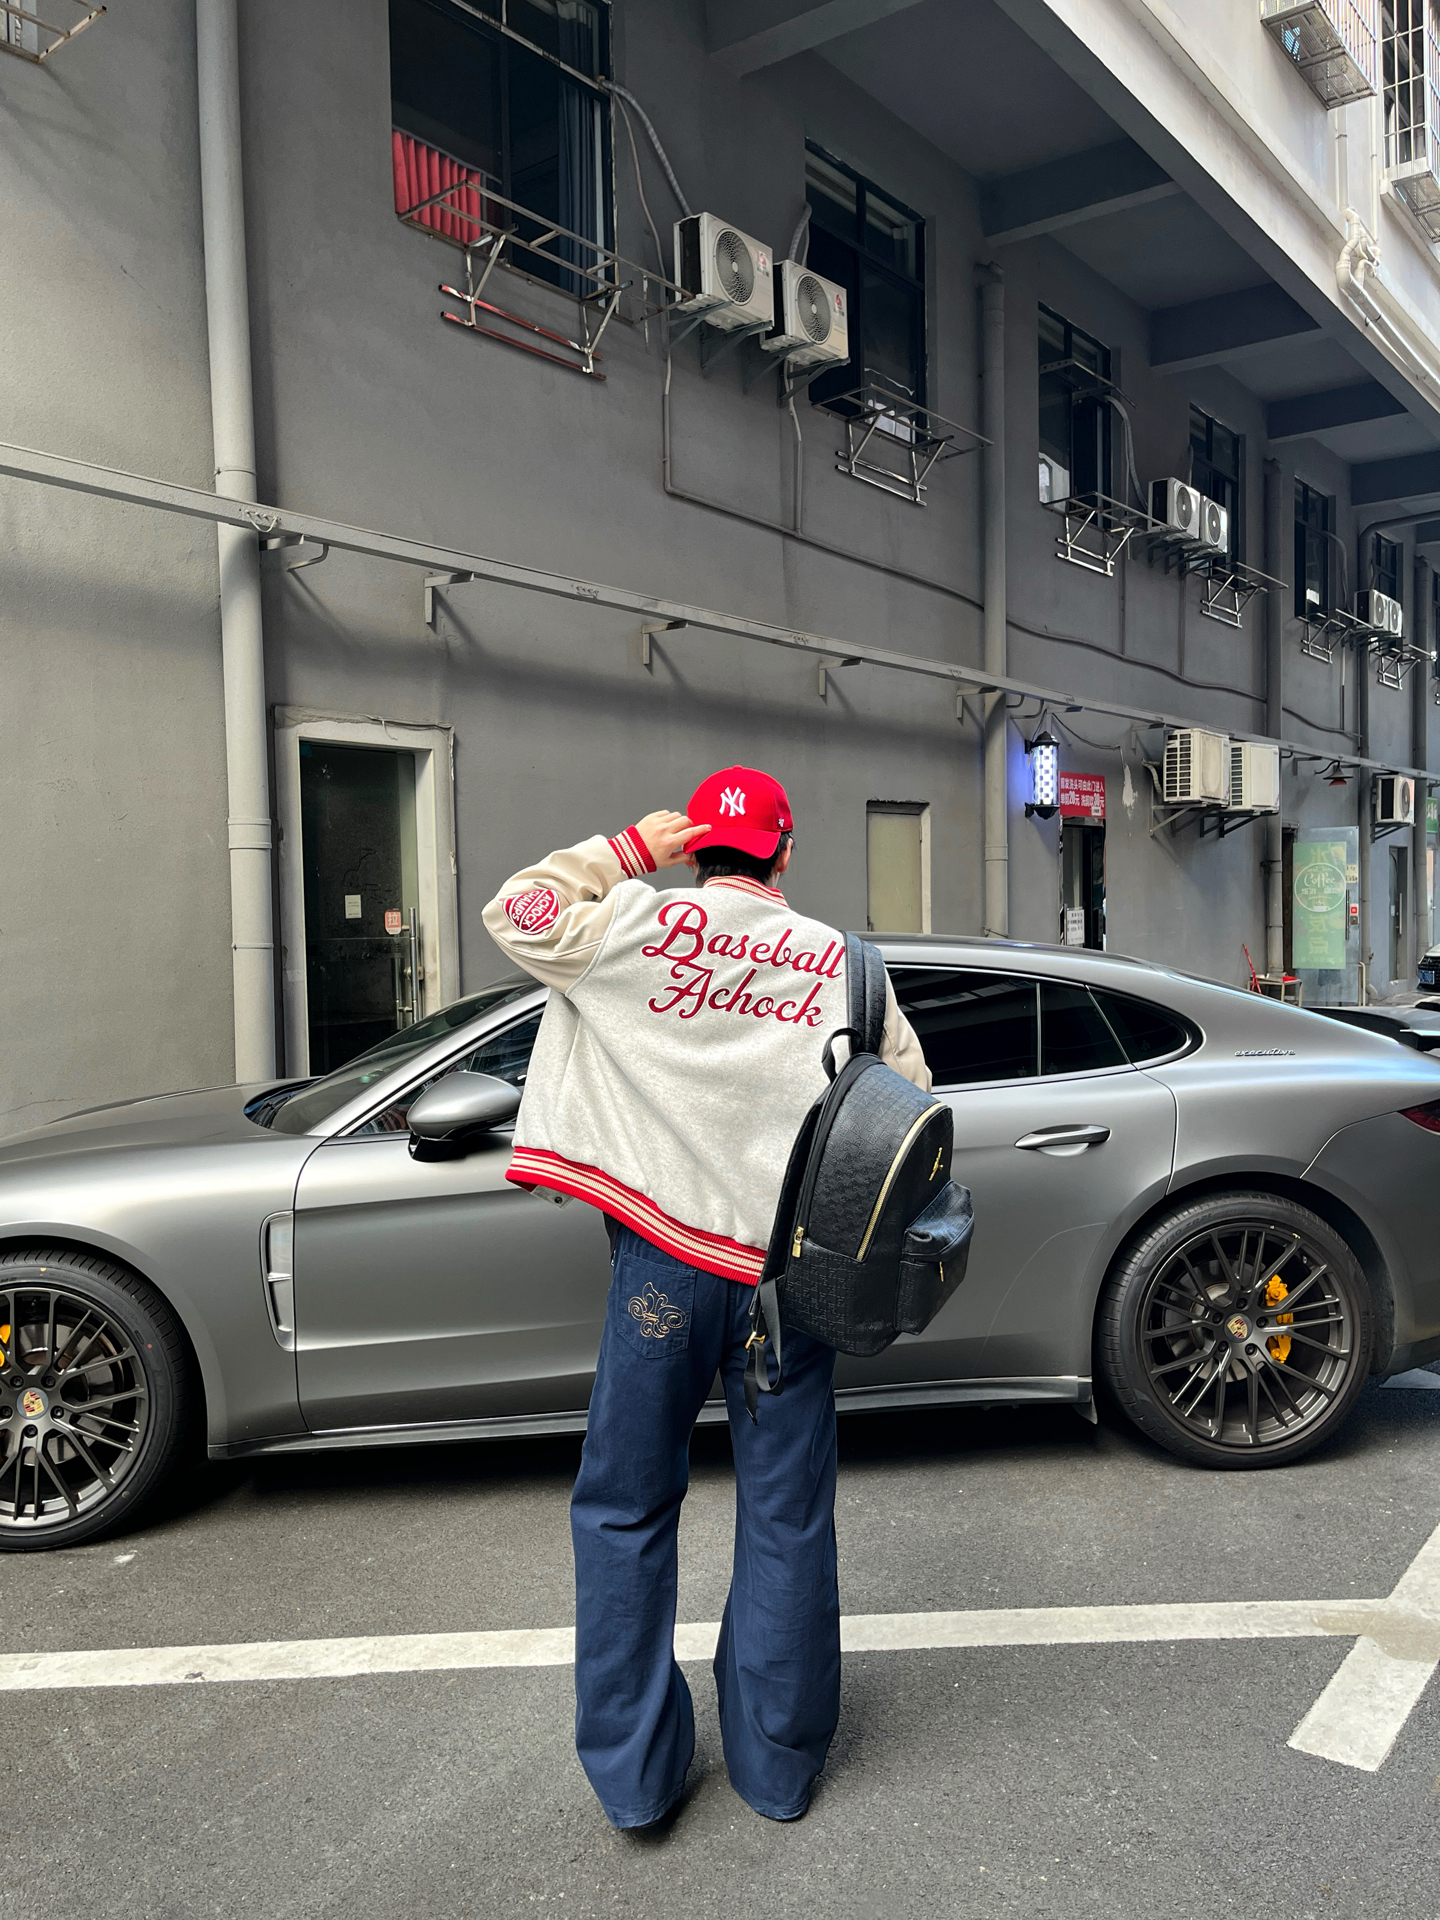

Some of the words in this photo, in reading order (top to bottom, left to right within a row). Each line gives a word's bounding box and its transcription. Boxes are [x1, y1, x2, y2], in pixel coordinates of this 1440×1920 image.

[1304, 872, 1336, 888] Coffee
[388, 912, 399, 926] 拉
[512, 890, 541, 922] CHAMPS
[522, 893, 553, 928] ACHOCK
[641, 900, 846, 979] Baseball
[648, 960, 824, 1028] Achock
[1234, 1047, 1296, 1057] executive
